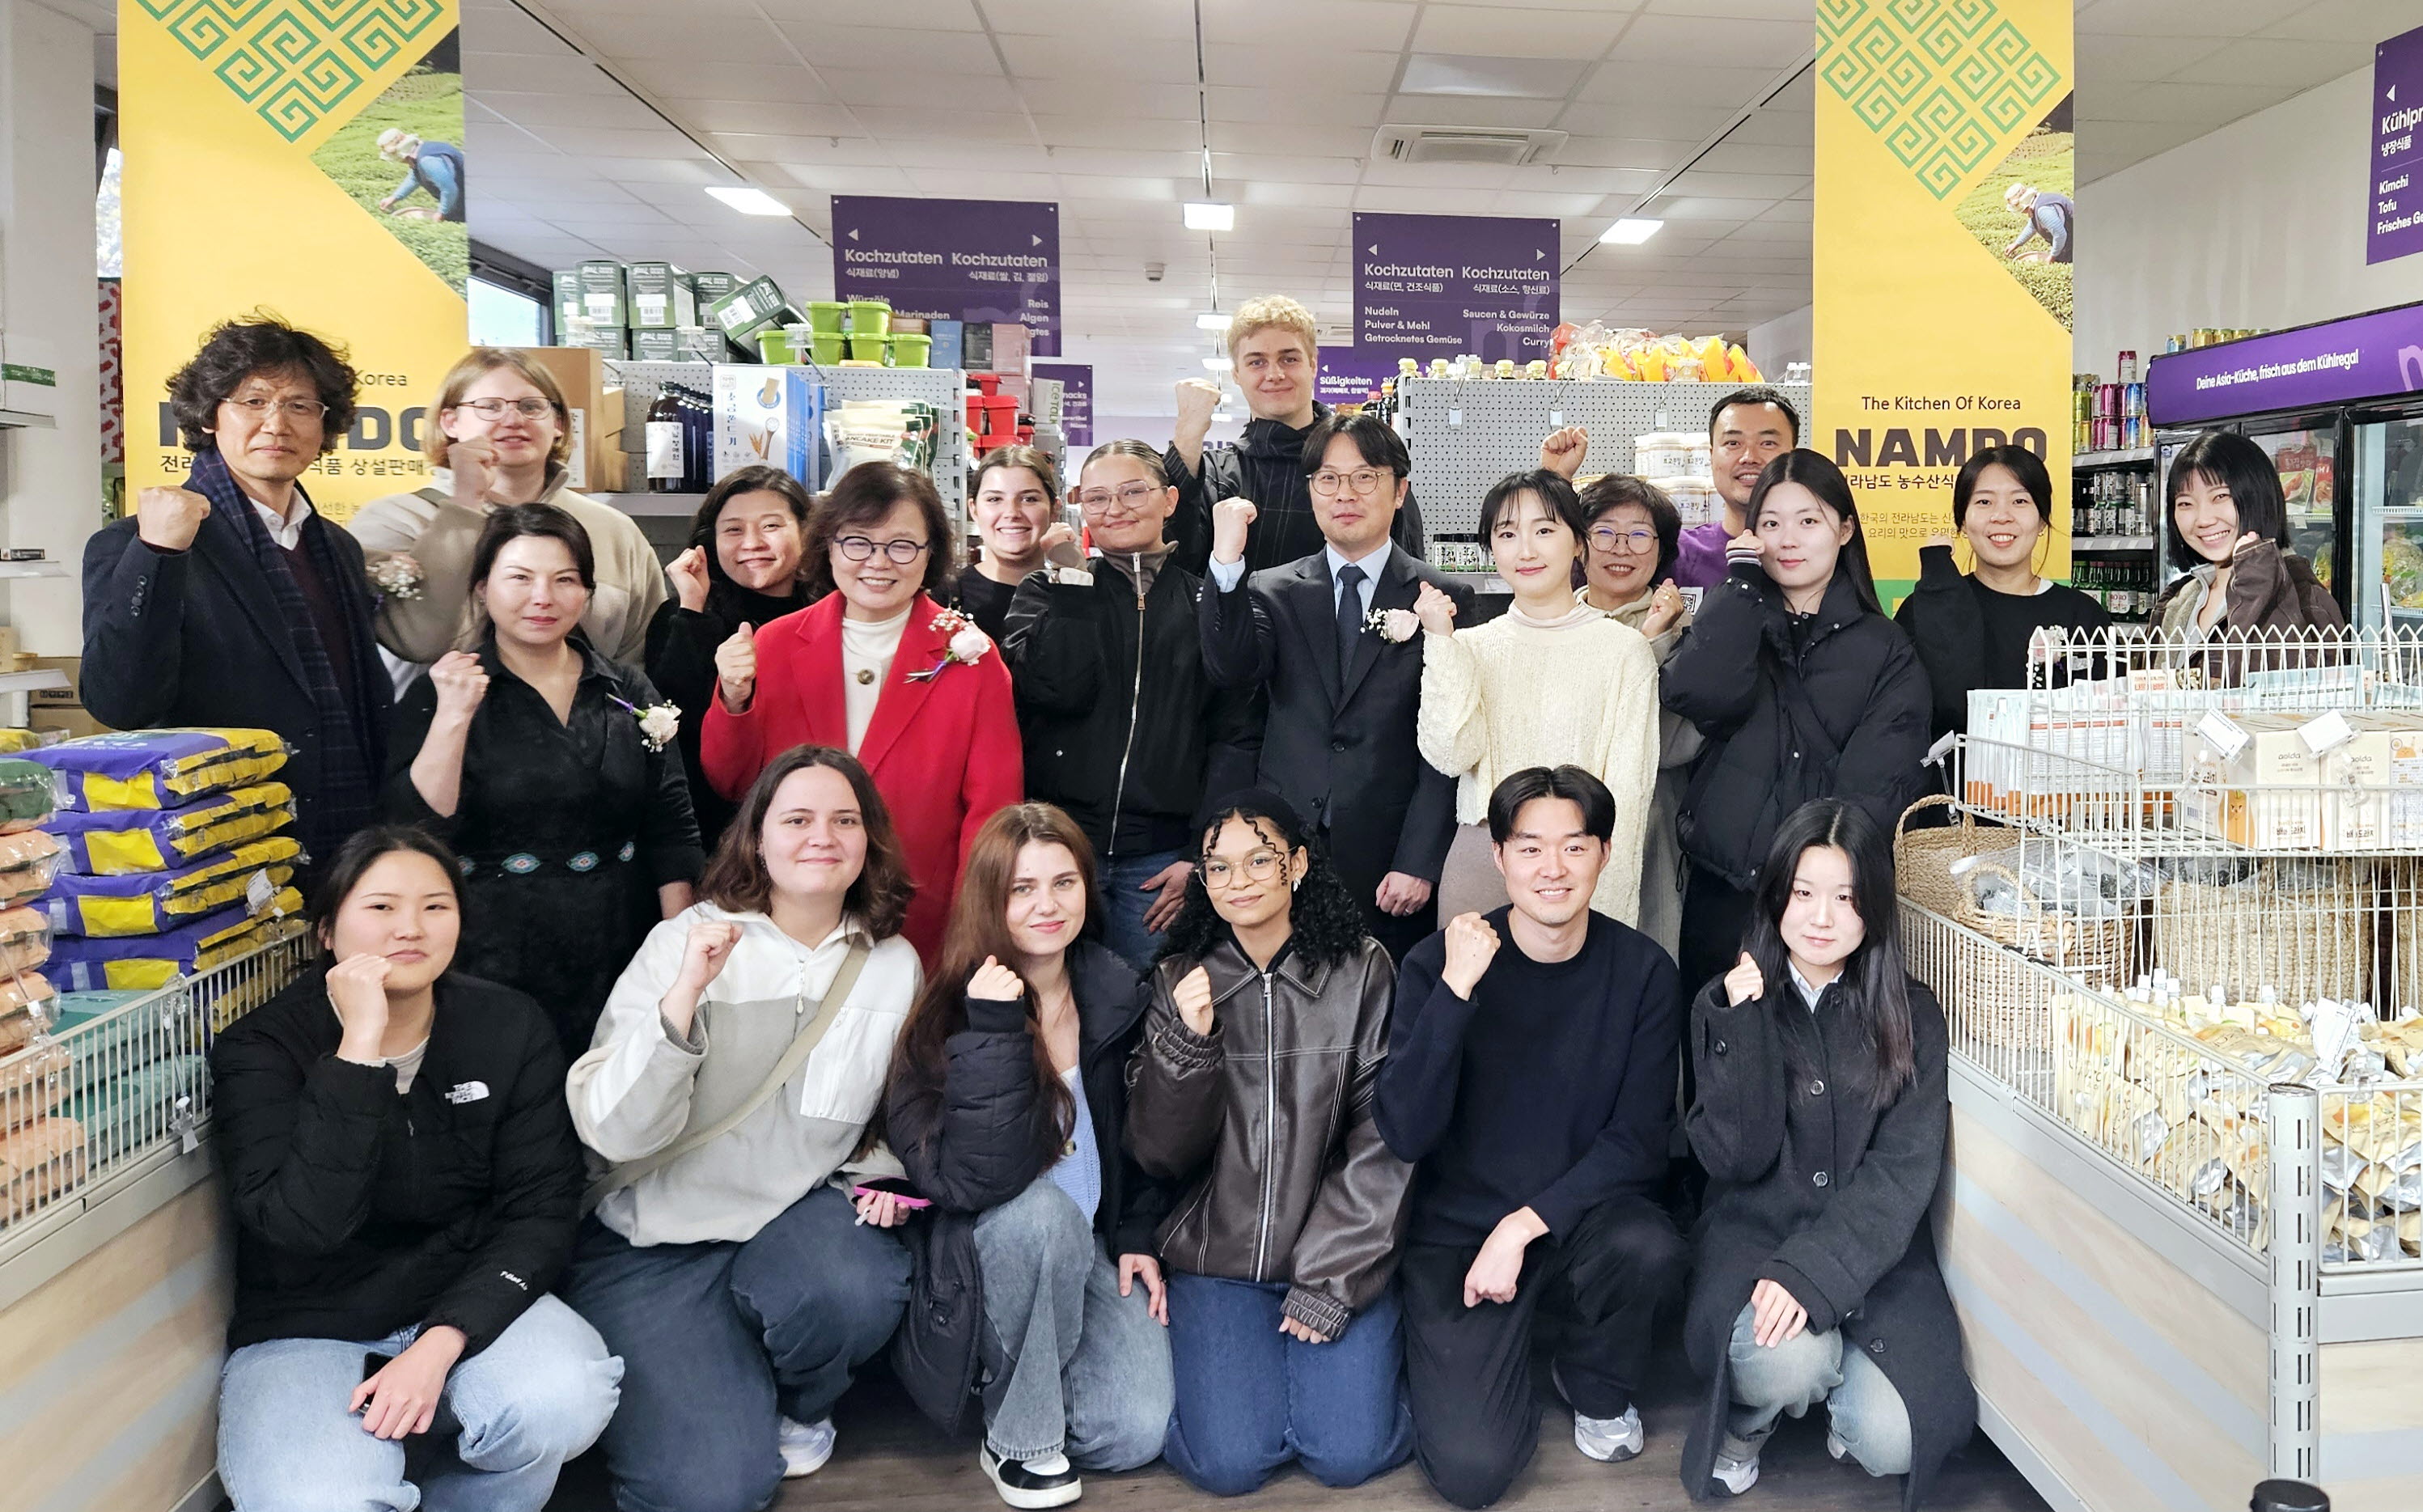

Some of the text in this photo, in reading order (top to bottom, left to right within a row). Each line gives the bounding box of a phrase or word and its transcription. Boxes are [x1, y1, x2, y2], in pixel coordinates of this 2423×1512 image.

[2382, 135, 2412, 157] 냉장식품
[2379, 174, 2409, 195] Kimchi
[2378, 200, 2397, 214] Tofu
[2377, 217, 2412, 235] Frisches
[845, 248, 943, 265] Kochzutaten
[952, 252, 1048, 267] Kochzutaten
[1365, 263, 1454, 278] Kochzutaten
[1462, 266, 1550, 281] Kochzutaten
[1027, 299, 1049, 308] Reis
[895, 309, 951, 320] Marinaden
[1019, 312, 1049, 324] Algen
[1365, 307, 1399, 316] Nudeln
[1463, 309, 1550, 320] Saucen & Gewürze
[1365, 320, 1430, 330] Pulver & Mehl
[1497, 324, 1550, 333] Kokosmilch
[1365, 332, 1463, 345] Getrocknetes Gemüse
[1523, 337, 1550, 348] Curry
[2196, 349, 2359, 390] Deine Asia-Küche, frisch aus dem Kühlregal
[1320, 375, 1373, 388] Süßigkeiten
[1062, 392, 1088, 400] nacks
[1862, 396, 2021, 410] The Kitchen Of Korea
[349, 458, 437, 476] 상설판매
[1845, 474, 1955, 489] 라남도 농수산식
[1860, 512, 1888, 524] 한국의
[1891, 512, 1939, 524] 전라남도는
[1867, 527, 1896, 539] 요리의
[1900, 527, 1928, 540] 맛으로
